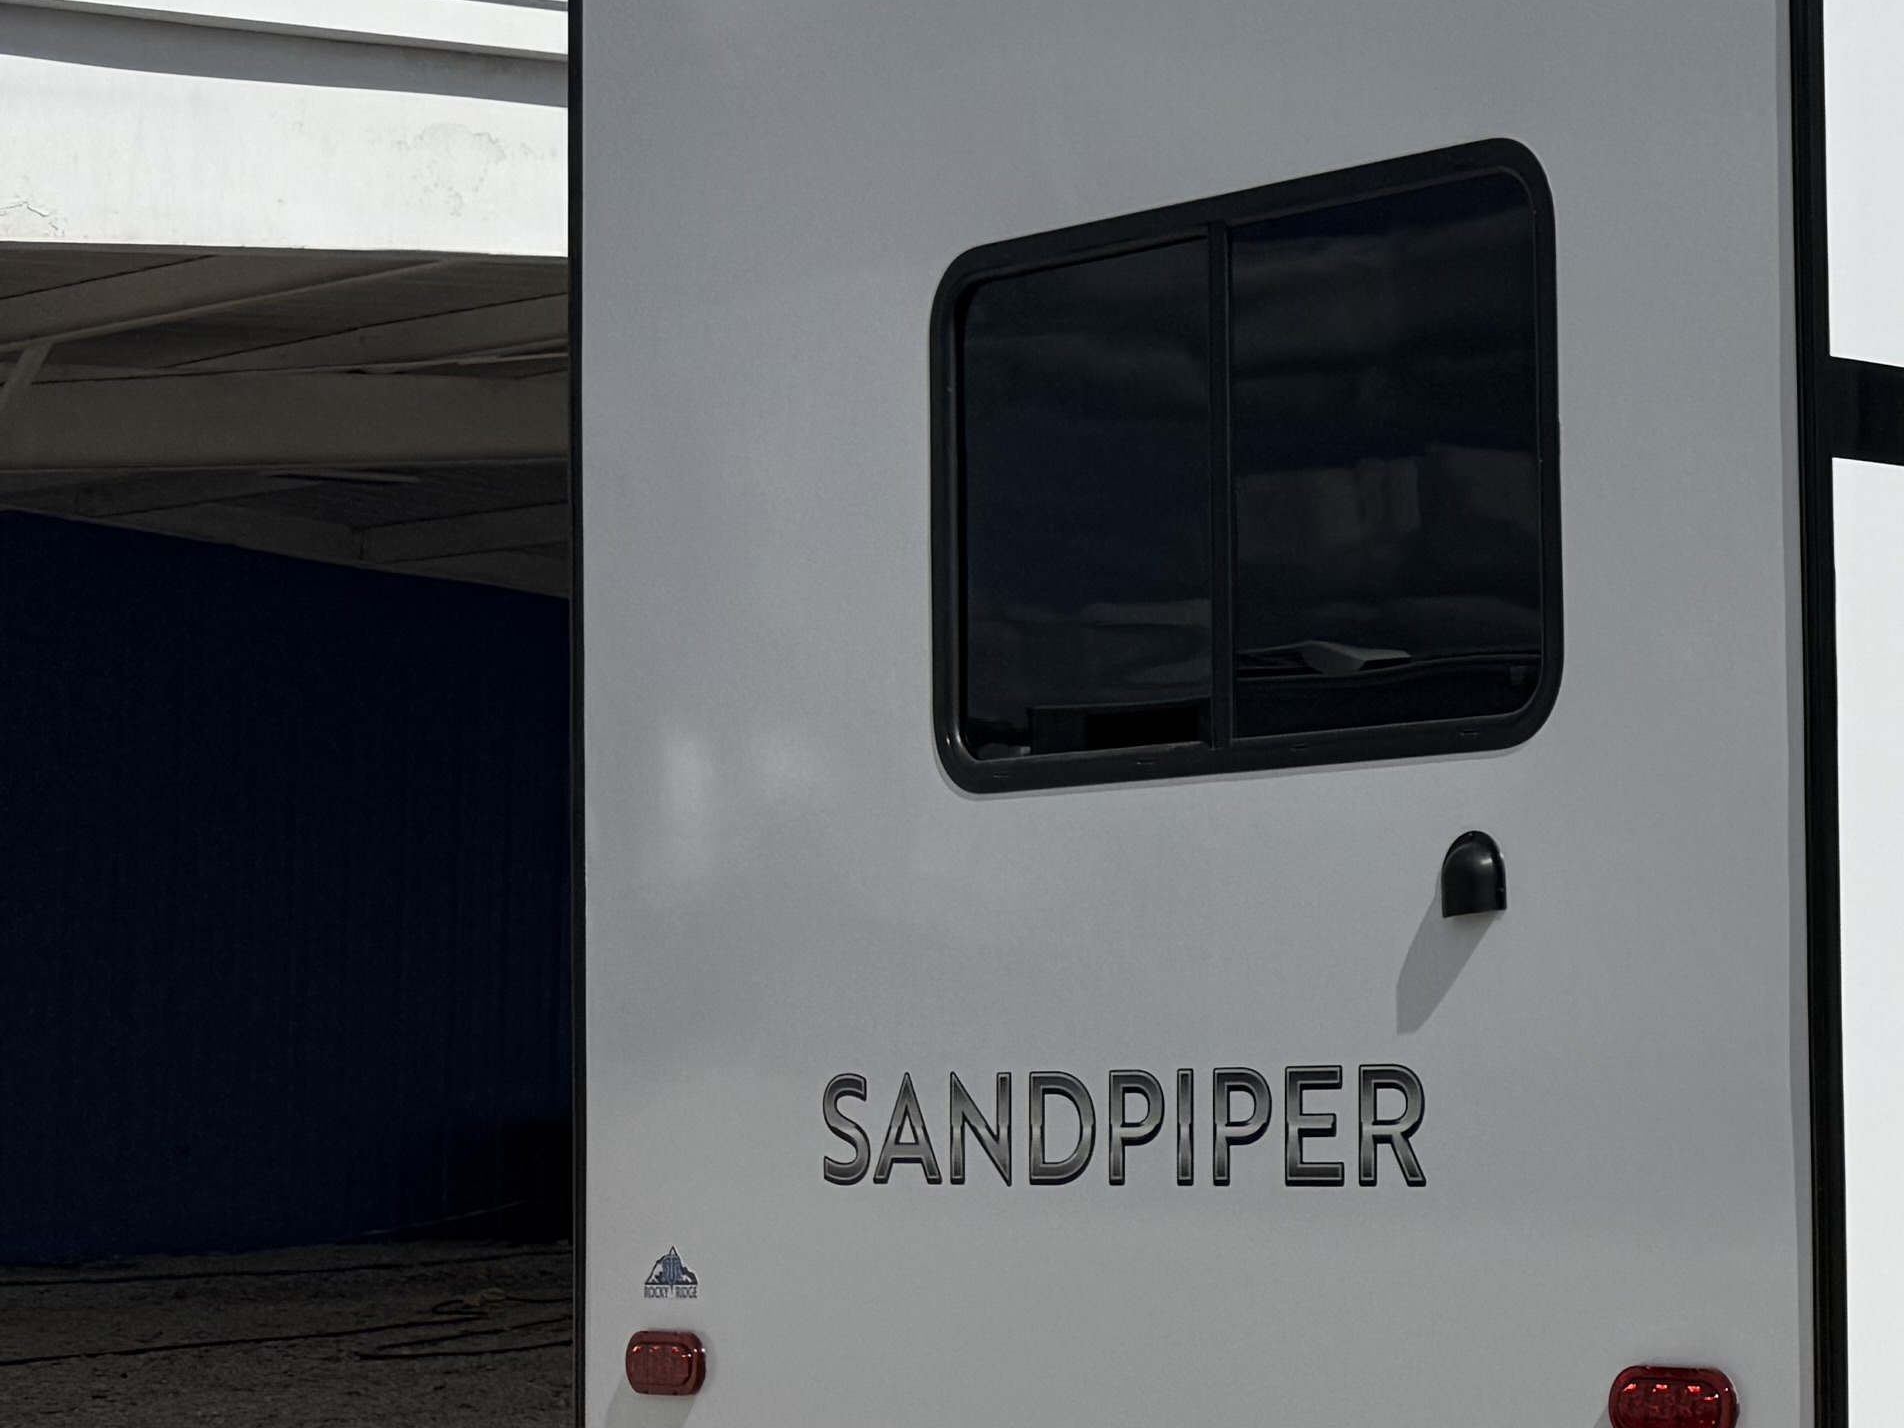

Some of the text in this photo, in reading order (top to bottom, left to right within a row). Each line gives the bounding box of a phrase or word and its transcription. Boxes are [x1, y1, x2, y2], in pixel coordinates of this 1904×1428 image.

[822, 1063, 1427, 1188] SANDPIPER
[644, 1286, 698, 1299] ROCKY RIDGE
